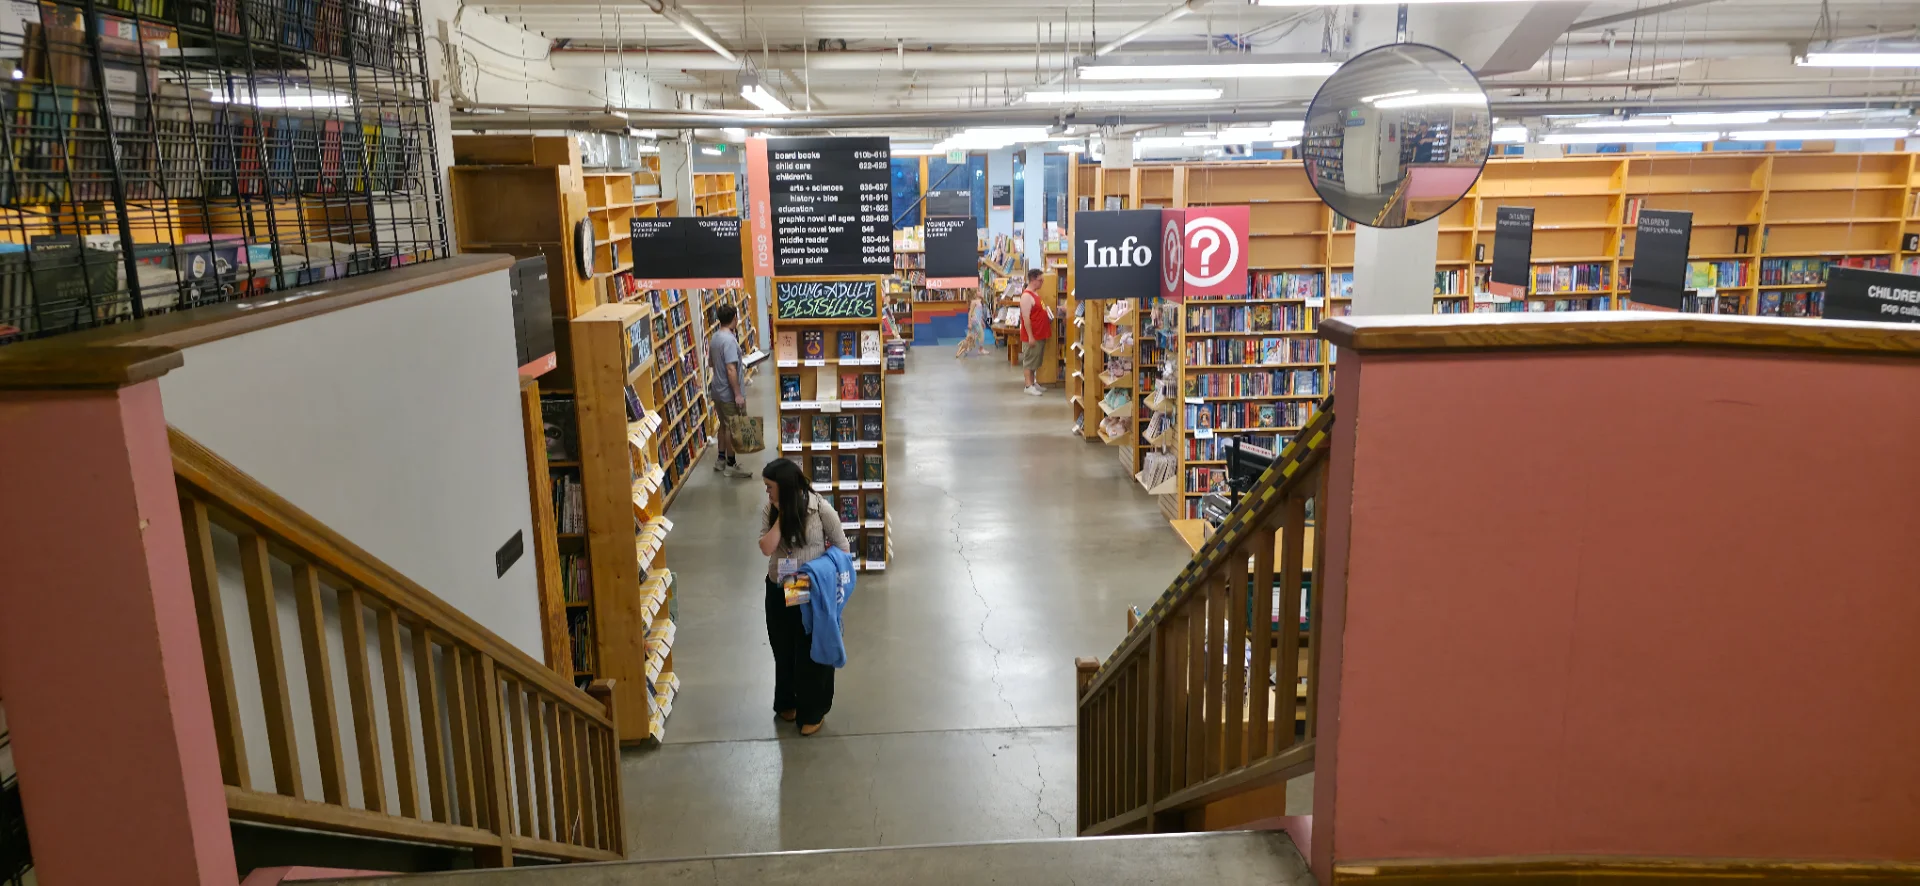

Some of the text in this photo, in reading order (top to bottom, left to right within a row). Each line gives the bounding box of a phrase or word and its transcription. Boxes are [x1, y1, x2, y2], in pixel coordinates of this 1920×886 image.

[775, 151, 820, 159] board books
[776, 162, 793, 170] child
[790, 195, 814, 203] history
[778, 205, 813, 213] education
[779, 215, 805, 224] graphic
[779, 226, 806, 235] graphic
[828, 225, 844, 233] teen
[758, 234, 768, 267] rose
[780, 246, 805, 255] picture
[1084, 236, 1152, 268] Info
[781, 256, 823, 265] young adult
[637, 280, 653, 288] 642
[726, 279, 741, 288] 641
[926, 280, 942, 288] 640
[779, 281, 876, 302] YOUNG ADULT
[780, 297, 874, 318] BESTSELLERS
[1881, 303, 1899, 315] pop
